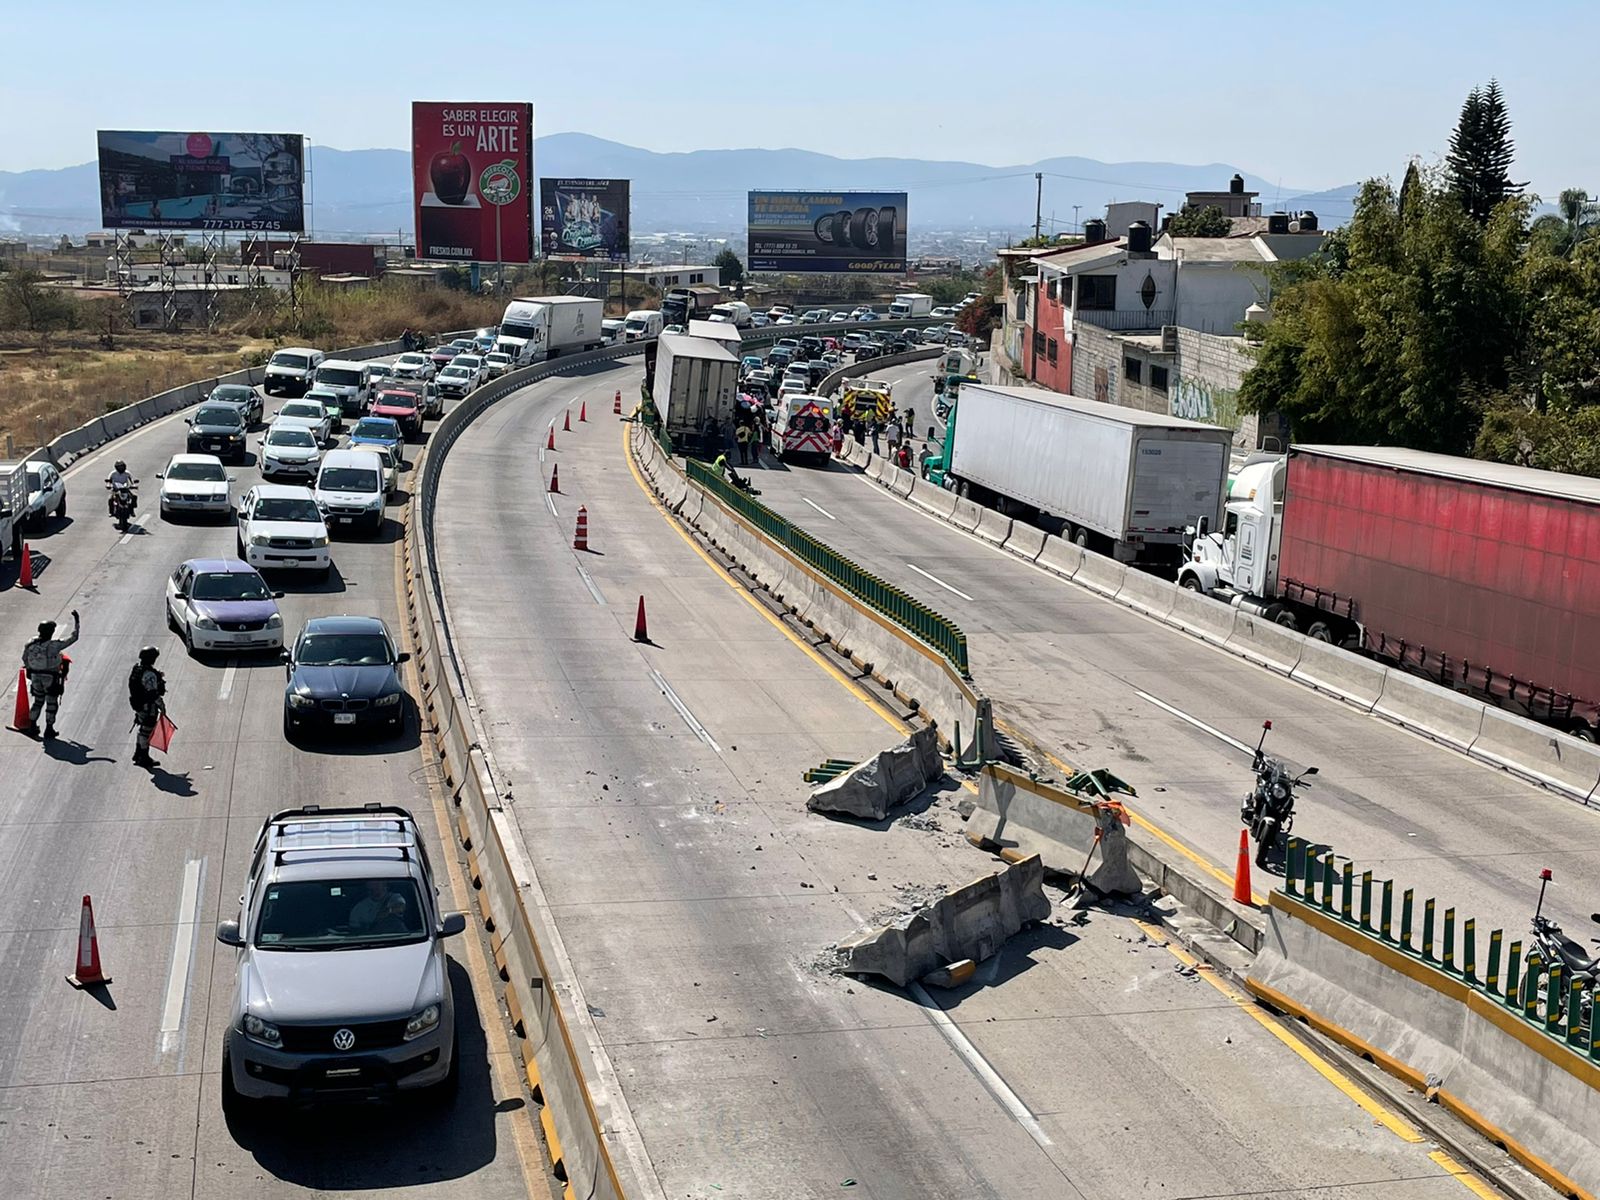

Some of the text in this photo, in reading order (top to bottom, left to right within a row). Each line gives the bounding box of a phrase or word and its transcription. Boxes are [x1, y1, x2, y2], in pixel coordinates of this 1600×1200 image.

[442, 109, 518, 123] SABER ELEGIR
[442, 124, 518, 152] ES UN ARTE
[544, 206, 553, 214] 26
[203, 219, 281, 230] 777-171-5745
[848, 260, 902, 271] GOODYEAR
